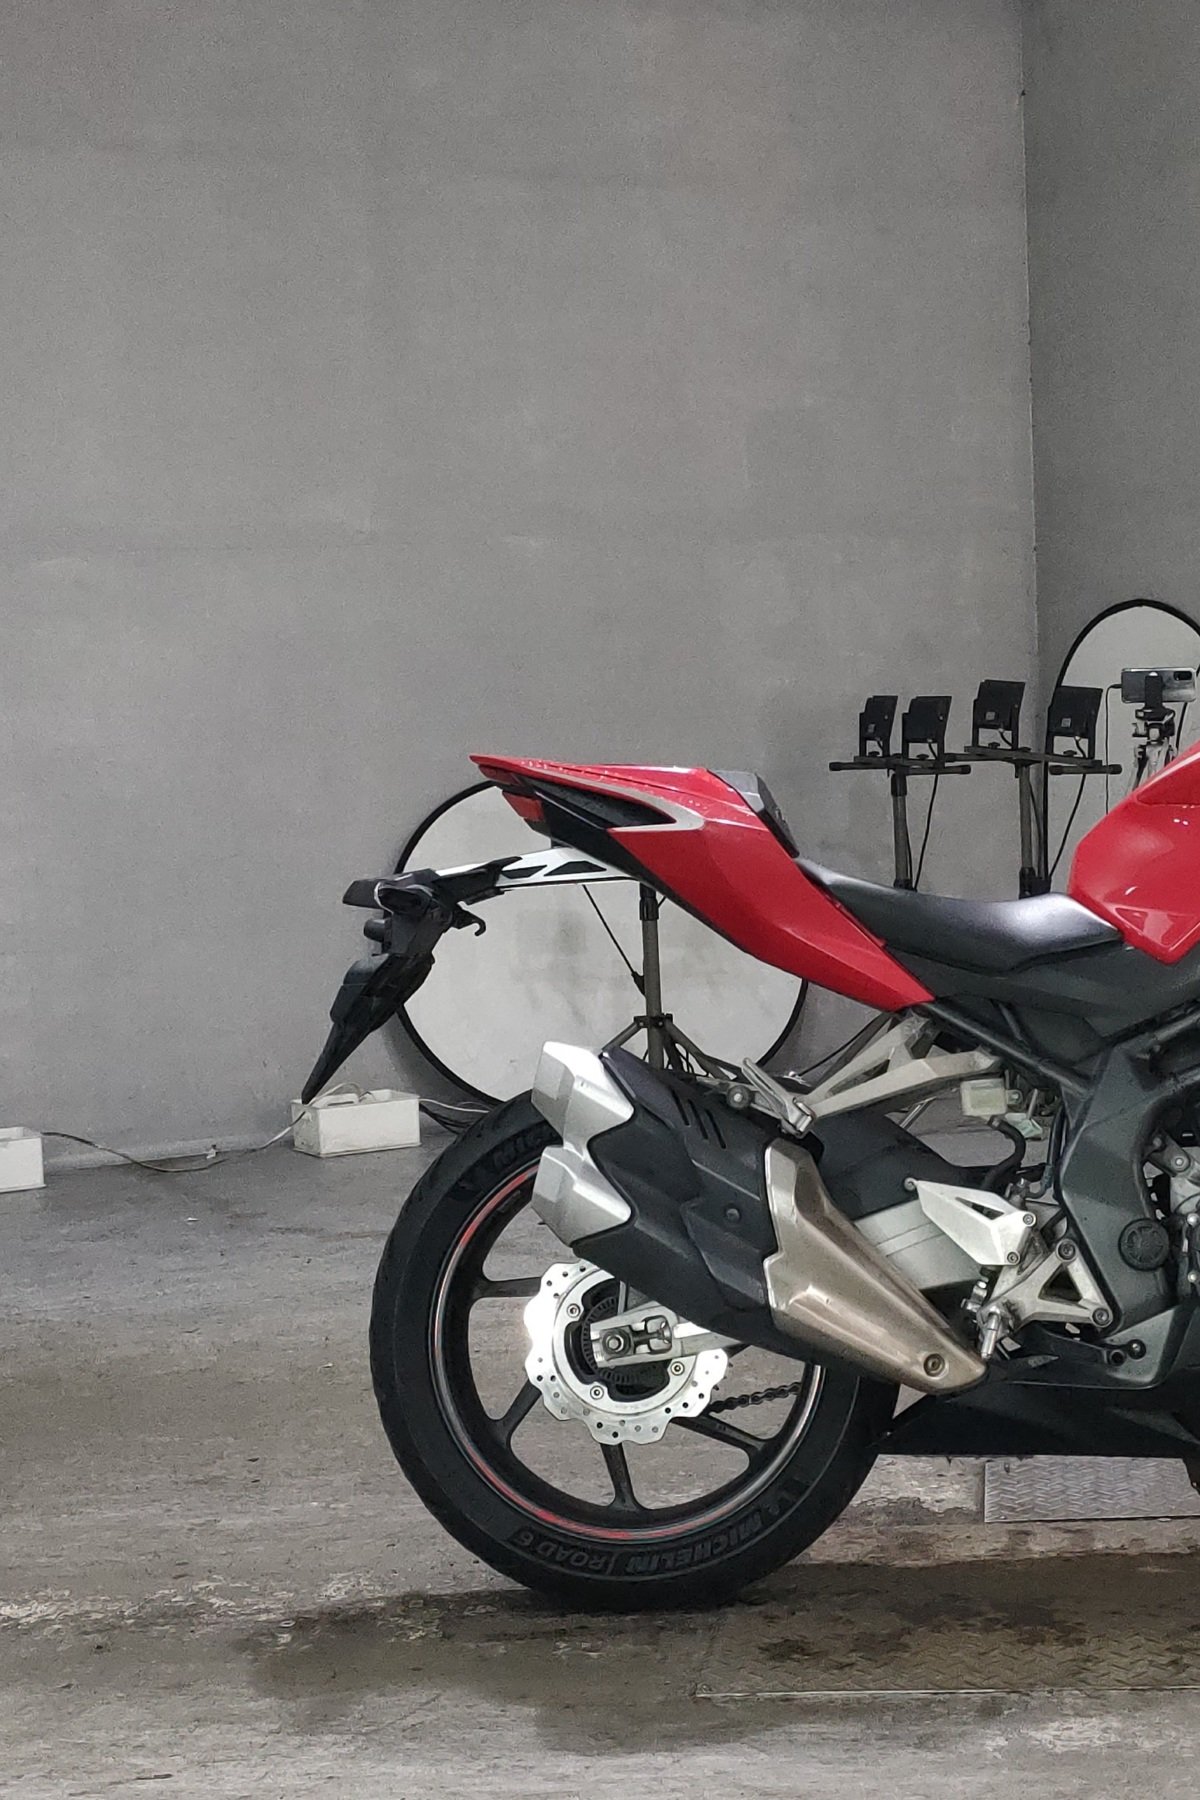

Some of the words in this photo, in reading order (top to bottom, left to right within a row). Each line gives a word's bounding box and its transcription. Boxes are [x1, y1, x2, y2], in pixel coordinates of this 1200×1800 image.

[520, 1531, 534, 1546] 6
[625, 1511, 761, 1573] MICHELIN
[536, 1541, 605, 1571] ROAD
